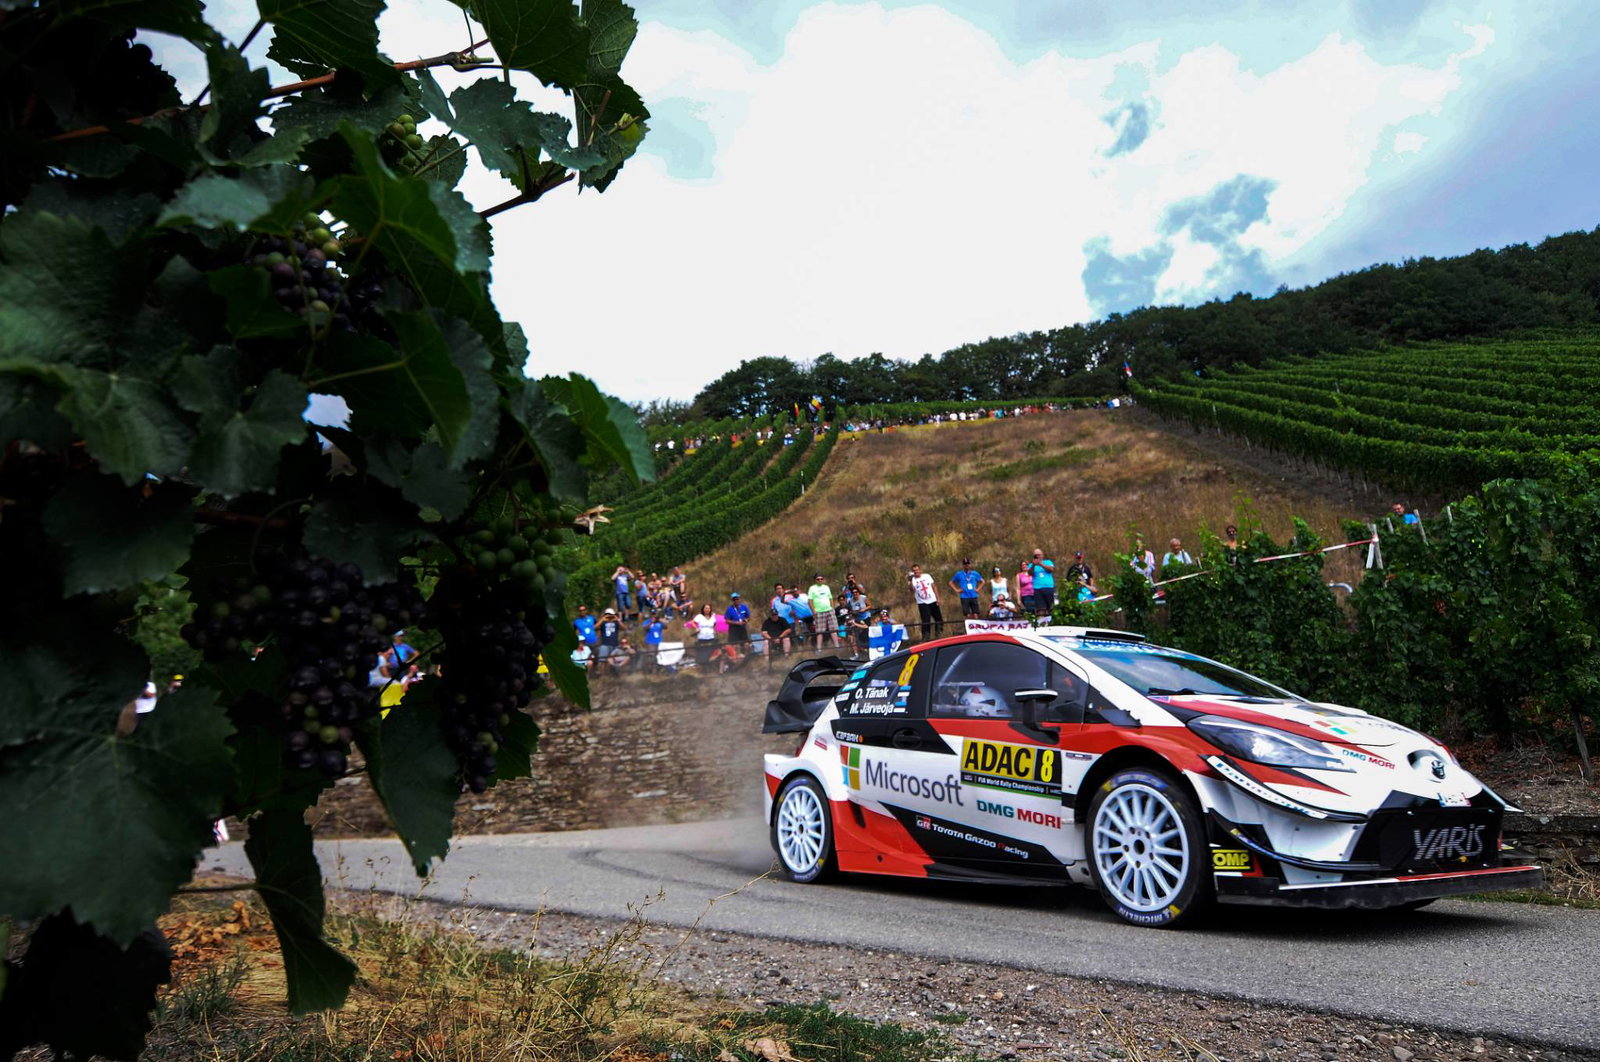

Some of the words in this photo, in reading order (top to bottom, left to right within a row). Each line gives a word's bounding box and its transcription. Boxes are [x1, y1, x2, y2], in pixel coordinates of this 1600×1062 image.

[898, 654, 919, 686] 8
[855, 688, 863, 699] O.
[865, 687, 889, 699] Tänak
[849, 703, 858, 714] M.
[860, 702, 895, 716] Järveoja
[964, 742, 1031, 777] ADAC
[1040, 749, 1054, 782] 8
[1342, 749, 1366, 761] DMG
[1368, 757, 1395, 770] MORI
[866, 758, 964, 806] Microsoft
[986, 778, 1000, 786] World
[977, 800, 1014, 818] DMG
[1017, 808, 1061, 829] MORI
[916, 820, 931, 830] GR
[932, 823, 964, 839] TOYOTA
[1213, 853, 1249, 866] OMP
[1118, 906, 1163, 923] MICHELIN
